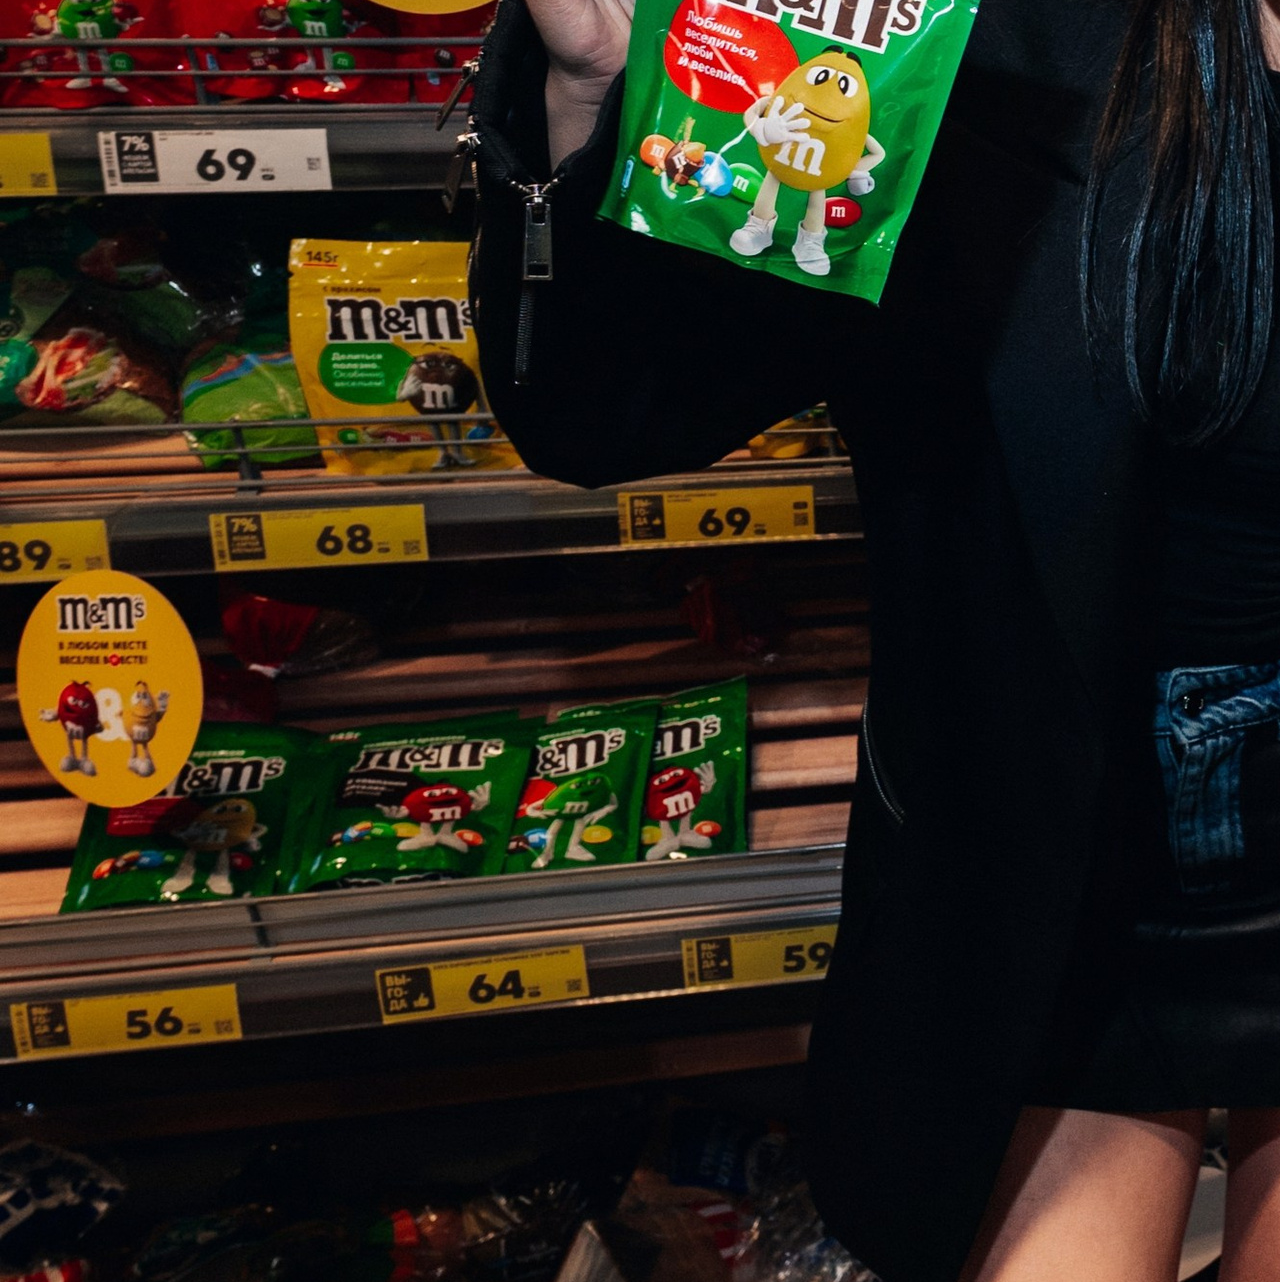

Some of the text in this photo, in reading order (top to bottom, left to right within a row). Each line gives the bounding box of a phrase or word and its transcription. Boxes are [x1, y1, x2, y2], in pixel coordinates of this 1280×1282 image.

[686, 9, 744, 40] Любишь
[683, 42, 714, 62] люби
[685, 27, 760, 62] веселиться,
[677, 55, 748, 88] и веселись
[121, 135, 151, 153] 7%
[773, 138, 827, 177] m
[196, 148, 257, 183] 69
[306, 250, 339, 264] 145г
[324, 296, 474, 344] m&m's
[420, 383, 457, 410] m
[229, 517, 259, 533] 7%
[698, 506, 752, 538] 69
[315, 524, 374, 556] 68
[0, 539, 53, 573] 89
[57, 594, 148, 633] m&m's
[67, 641, 108, 651] ЛЮБОМ
[113, 640, 148, 650] МЕСТЕ
[348, 738, 505, 774] m&m's
[531, 727, 627, 779] &m's
[429, 806, 462, 822] m
[661, 789, 697, 819] m
[783, 942, 834, 973] 59
[385, 974, 412, 987] ВЫ-
[387, 987, 408, 998] ГО-
[468, 969, 525, 1005] 64
[389, 1000, 409, 1012] ДА
[126, 1006, 184, 1040] 56
